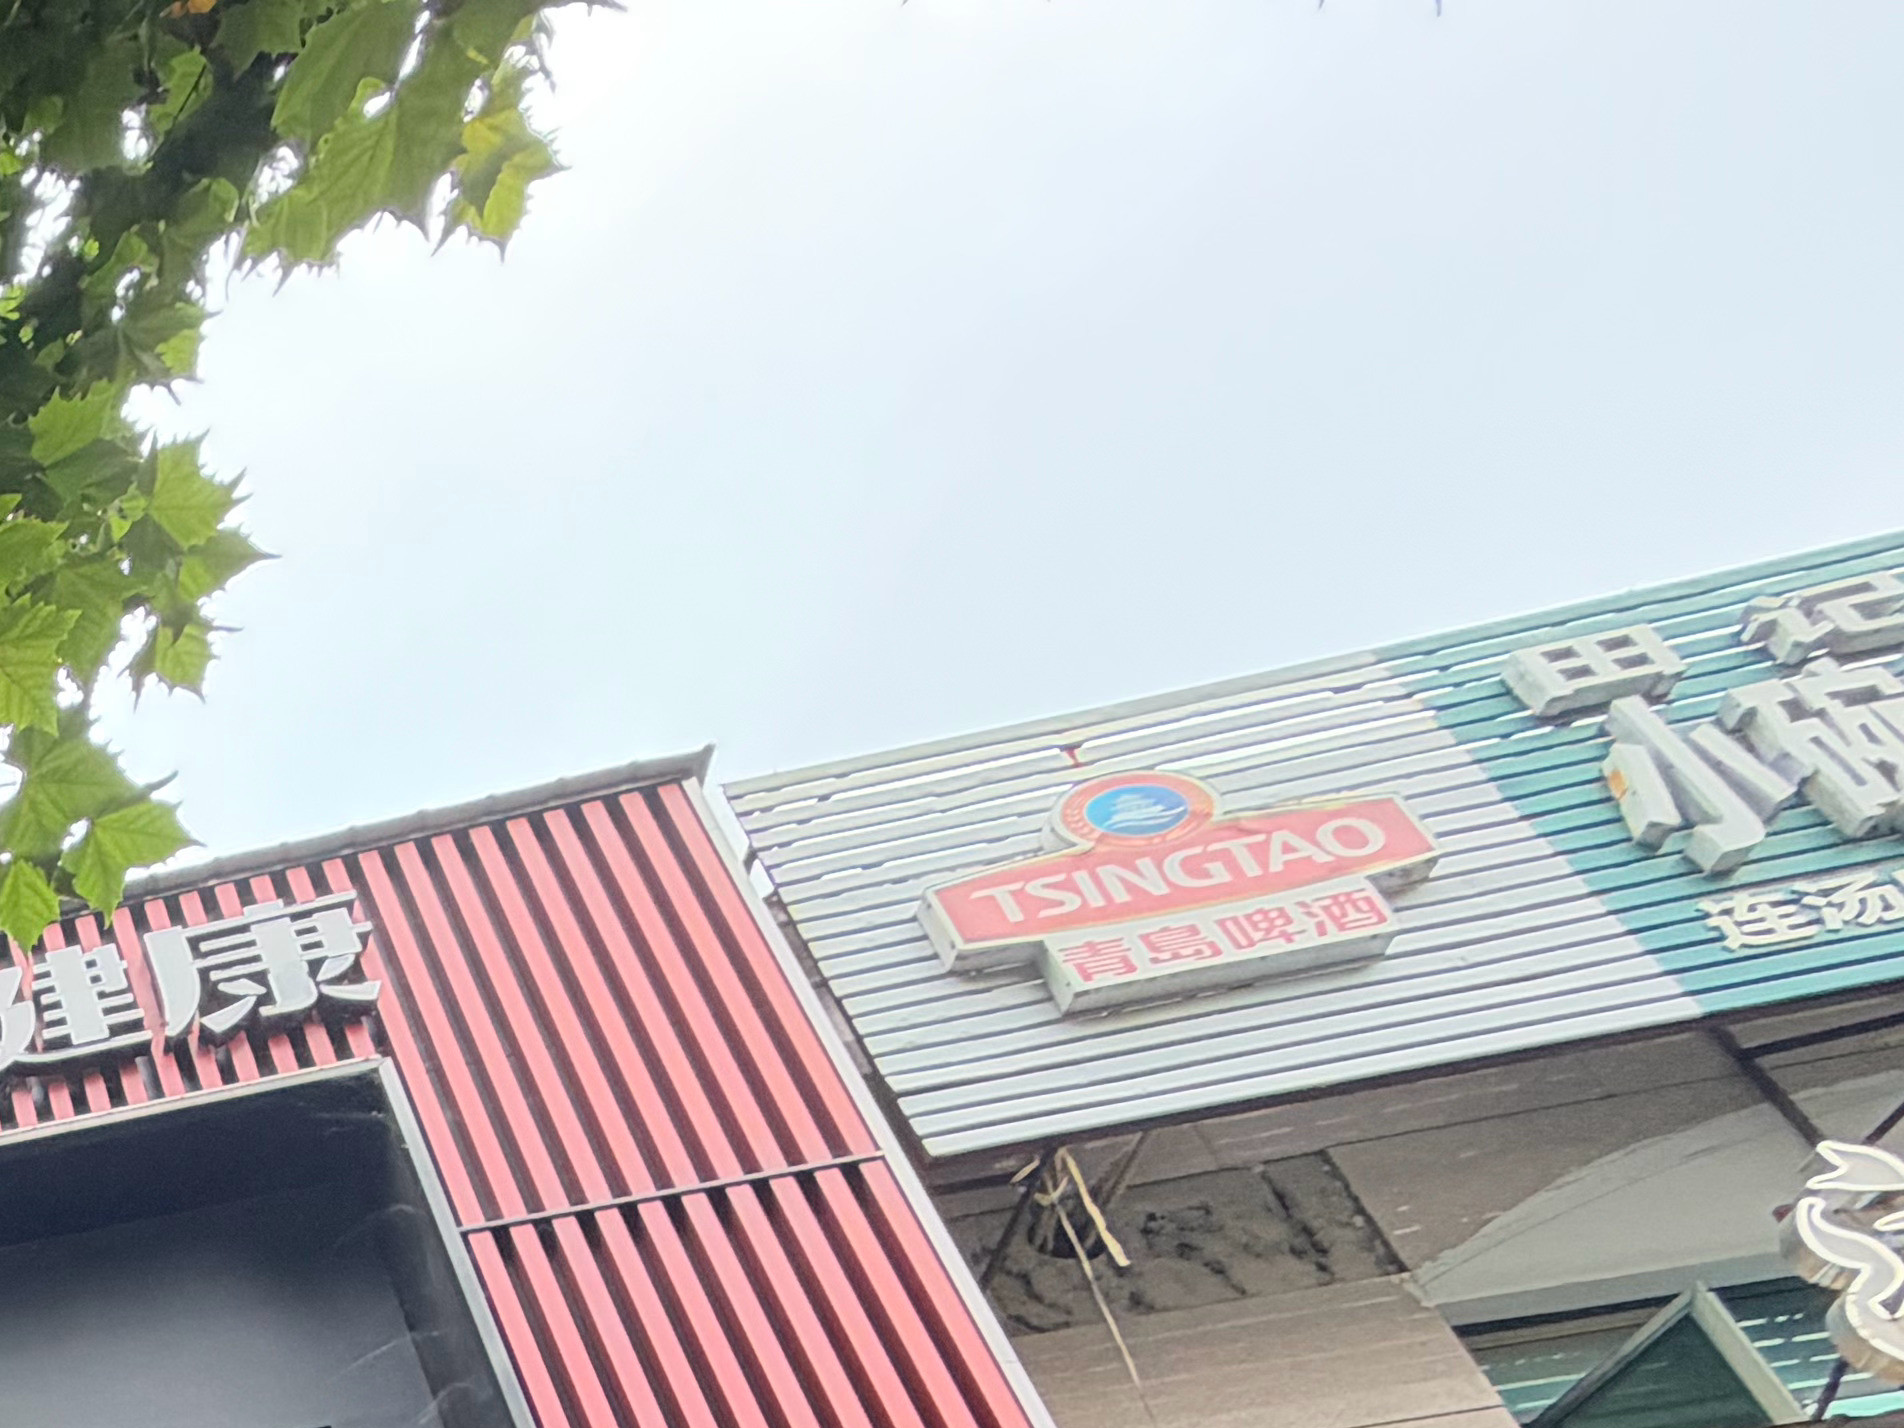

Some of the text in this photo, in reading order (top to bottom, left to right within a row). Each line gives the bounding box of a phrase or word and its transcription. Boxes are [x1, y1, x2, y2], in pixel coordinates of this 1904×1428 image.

[968, 812, 1388, 926] TSINGTAO
[1694, 870, 1904, 954] 连汤
[1060, 884, 1392, 986] 青岛啤酒
